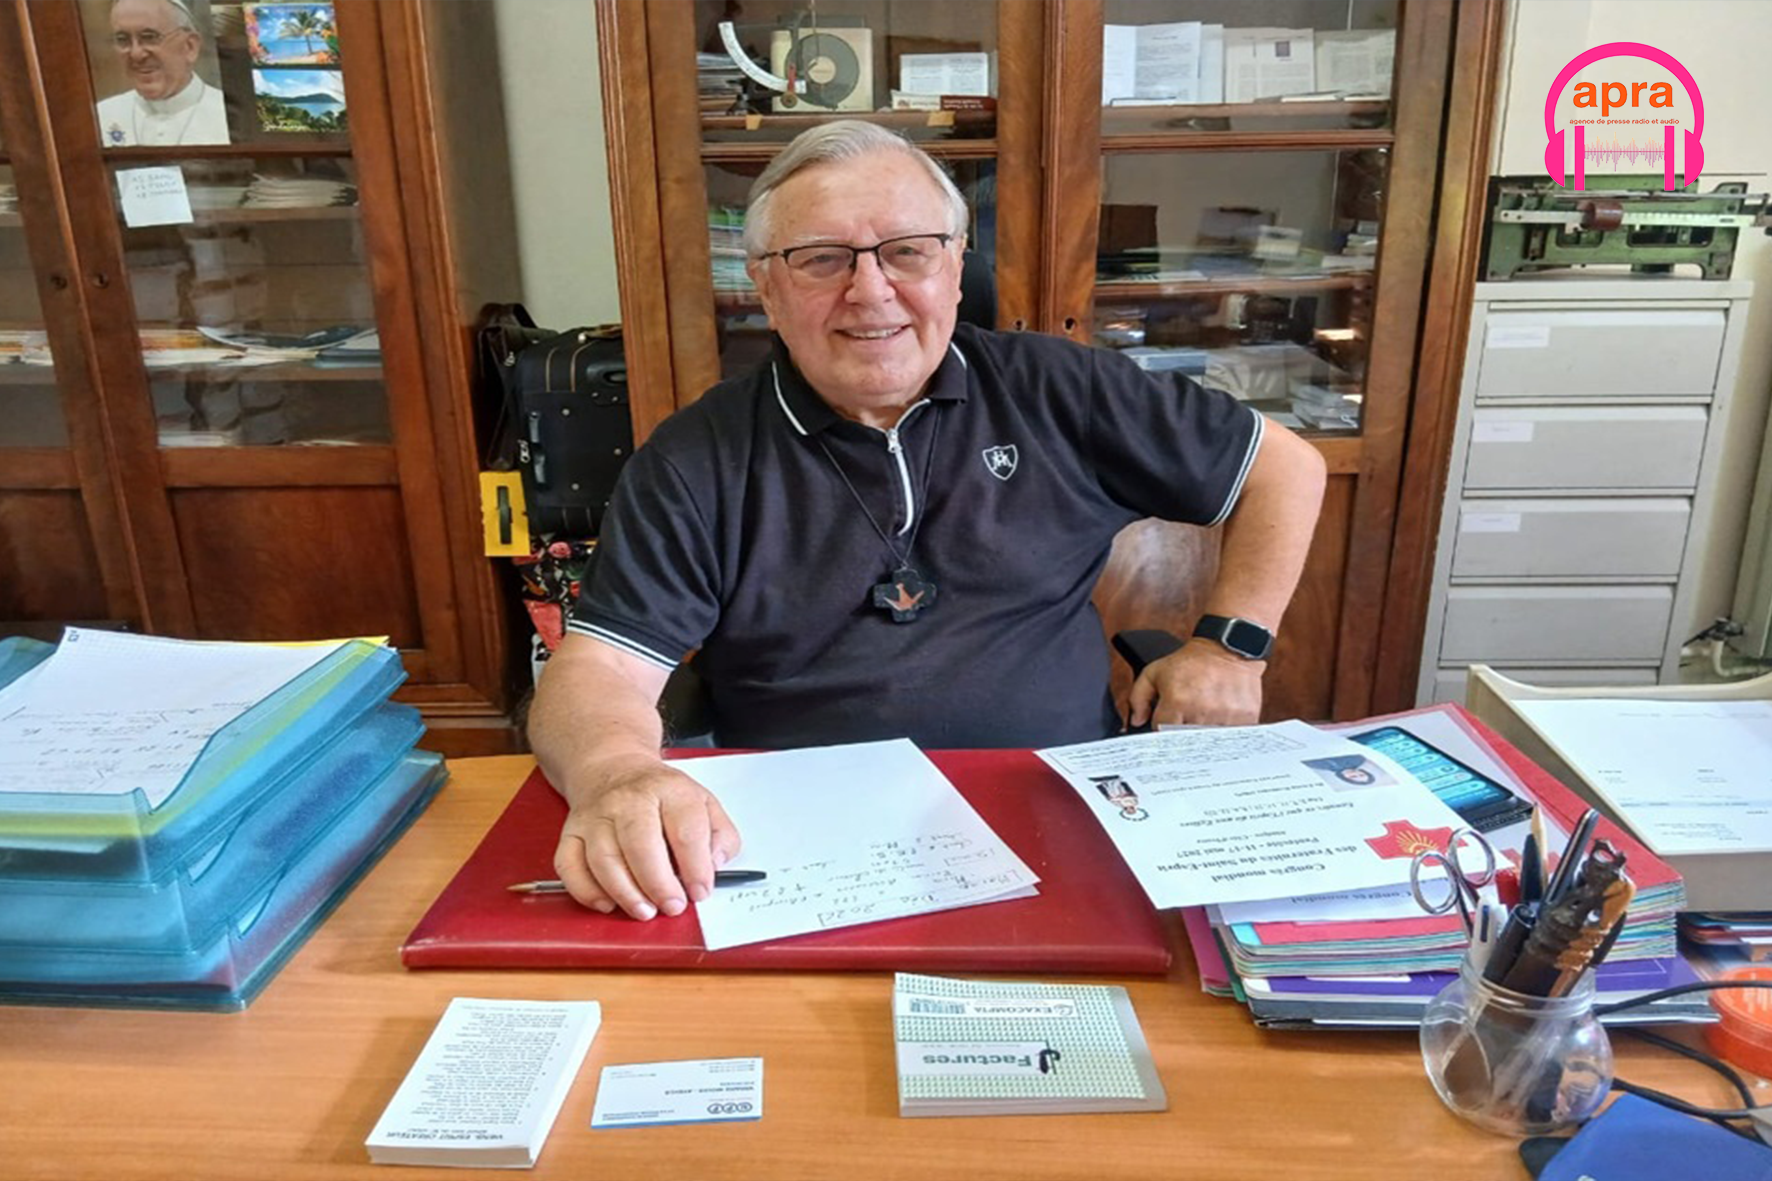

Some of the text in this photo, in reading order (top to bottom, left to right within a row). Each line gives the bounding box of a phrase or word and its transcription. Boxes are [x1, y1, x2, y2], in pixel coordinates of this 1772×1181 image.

[1156, 845, 1357, 873] des Fraternités du Saint-Esprit
[1210, 863, 1325, 883] Congrès mondial
[974, 1006, 1052, 1014] EXACOMPTA
[922, 1054, 1032, 1068] Factures
